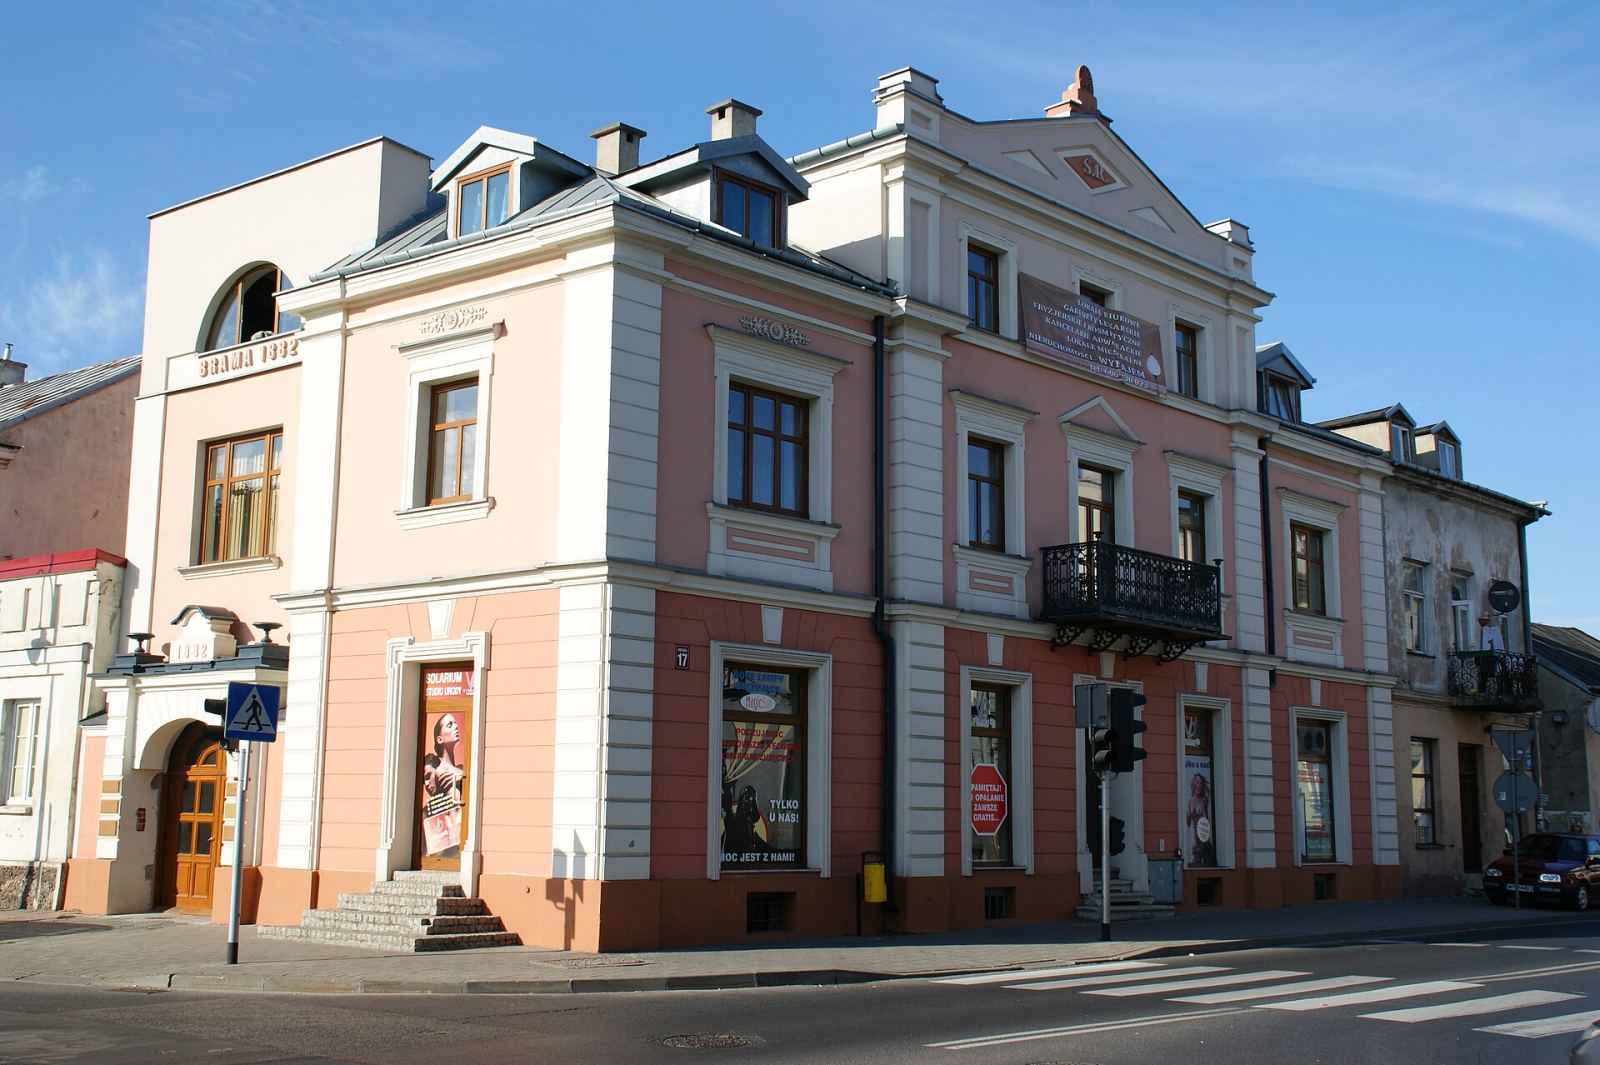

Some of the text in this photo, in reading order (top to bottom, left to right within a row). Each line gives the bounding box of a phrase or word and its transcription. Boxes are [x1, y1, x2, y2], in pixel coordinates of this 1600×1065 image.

[200, 348, 254, 378] BRAMA
[677, 652, 688, 667] 17
[425, 671, 463, 685] SOLARIUM
[971, 783, 1002, 794] PAMIĘTAJ!
[975, 793, 1005, 802] OPALANIE
[769, 799, 799, 810] TYLKO
[974, 803, 998, 812] ZAWSZE
[769, 811, 799, 824] U NAS!
[740, 852, 761, 863] JEST
[762, 852, 769, 863] Z
[770, 852, 795, 863] NAMI!
